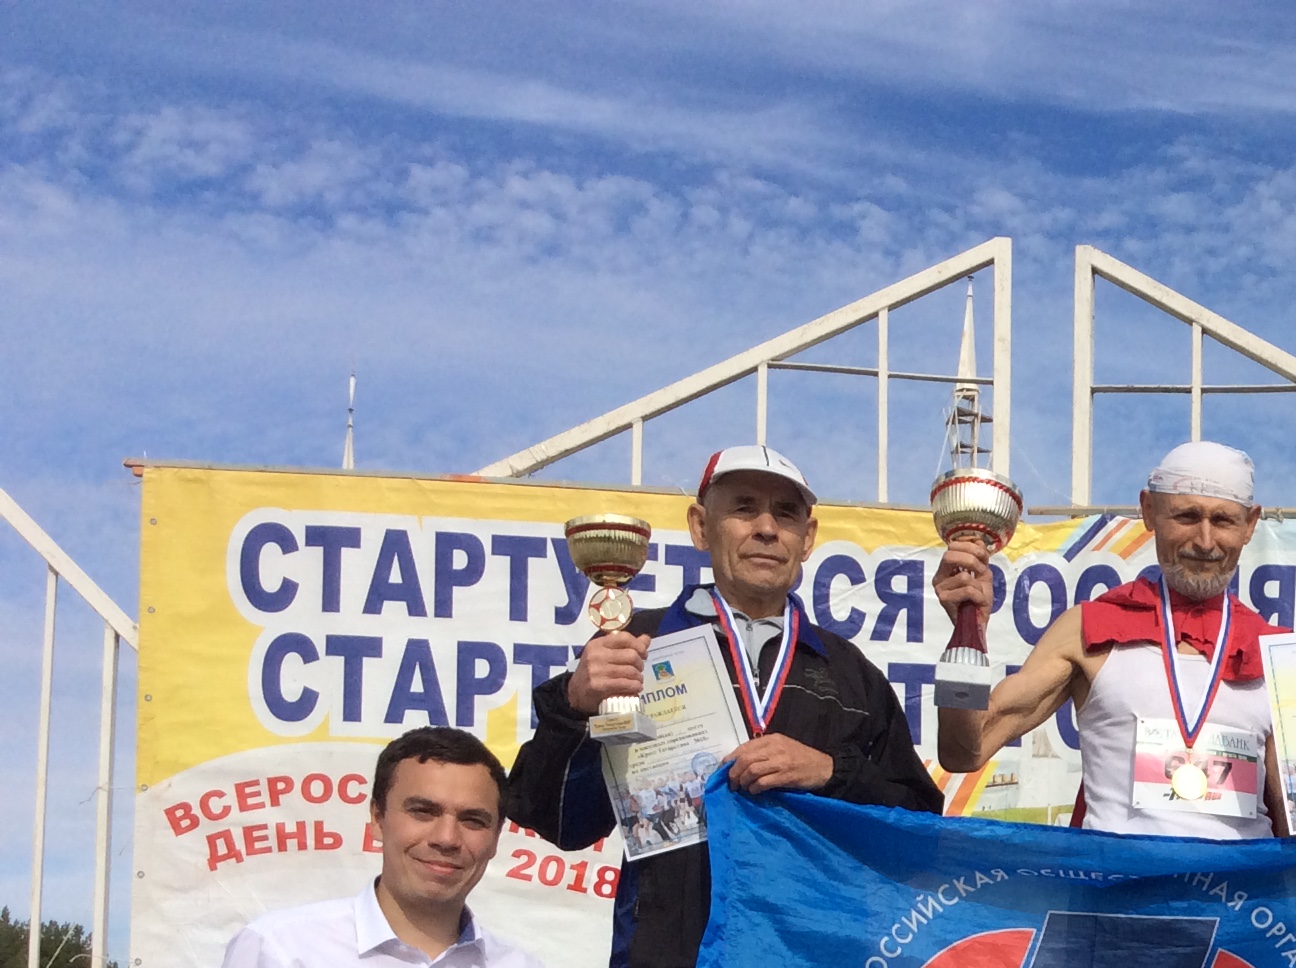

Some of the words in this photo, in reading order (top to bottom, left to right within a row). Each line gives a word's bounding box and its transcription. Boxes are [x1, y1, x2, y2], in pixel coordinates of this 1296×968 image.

[792, 553, 924, 643] СЯ
[261, 631, 586, 729] СТАРТ
[205, 820, 344, 871] ДЕНЬ
[506, 848, 621, 899] 2018
